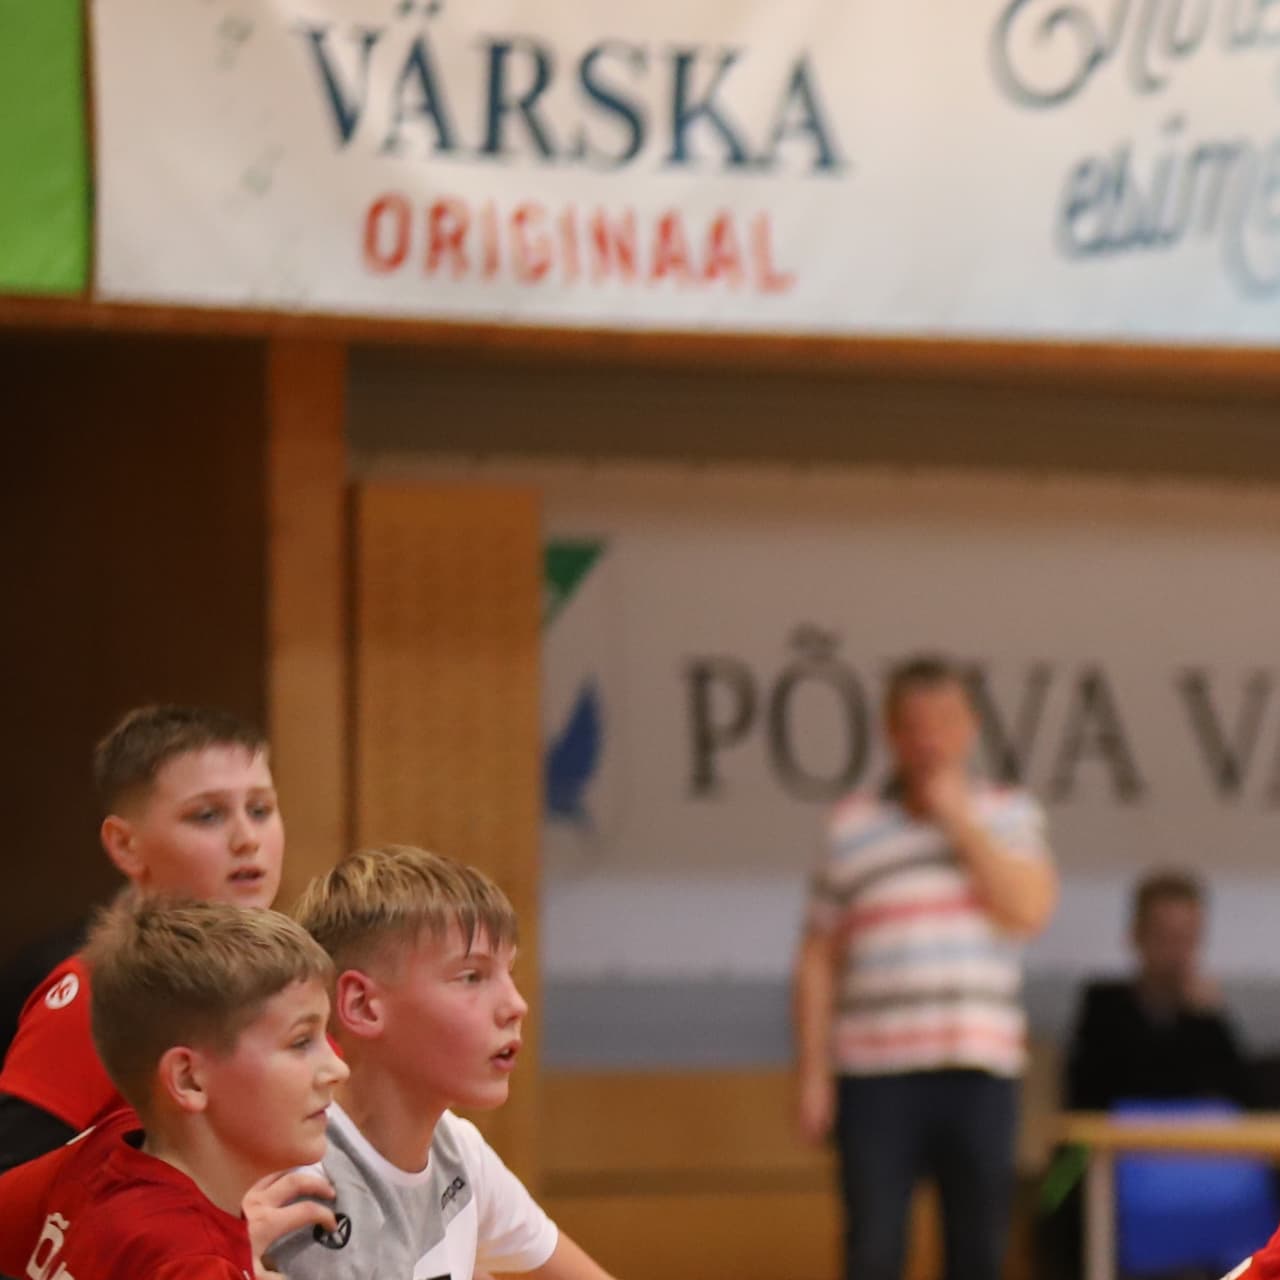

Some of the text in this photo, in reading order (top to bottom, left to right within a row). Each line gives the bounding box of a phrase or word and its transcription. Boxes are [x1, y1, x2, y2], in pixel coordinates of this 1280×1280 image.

[296, 0, 847, 178] VÄRSKA
[361, 190, 796, 295] ORIGINAAL
[682, 623, 1146, 805] PÕVA
